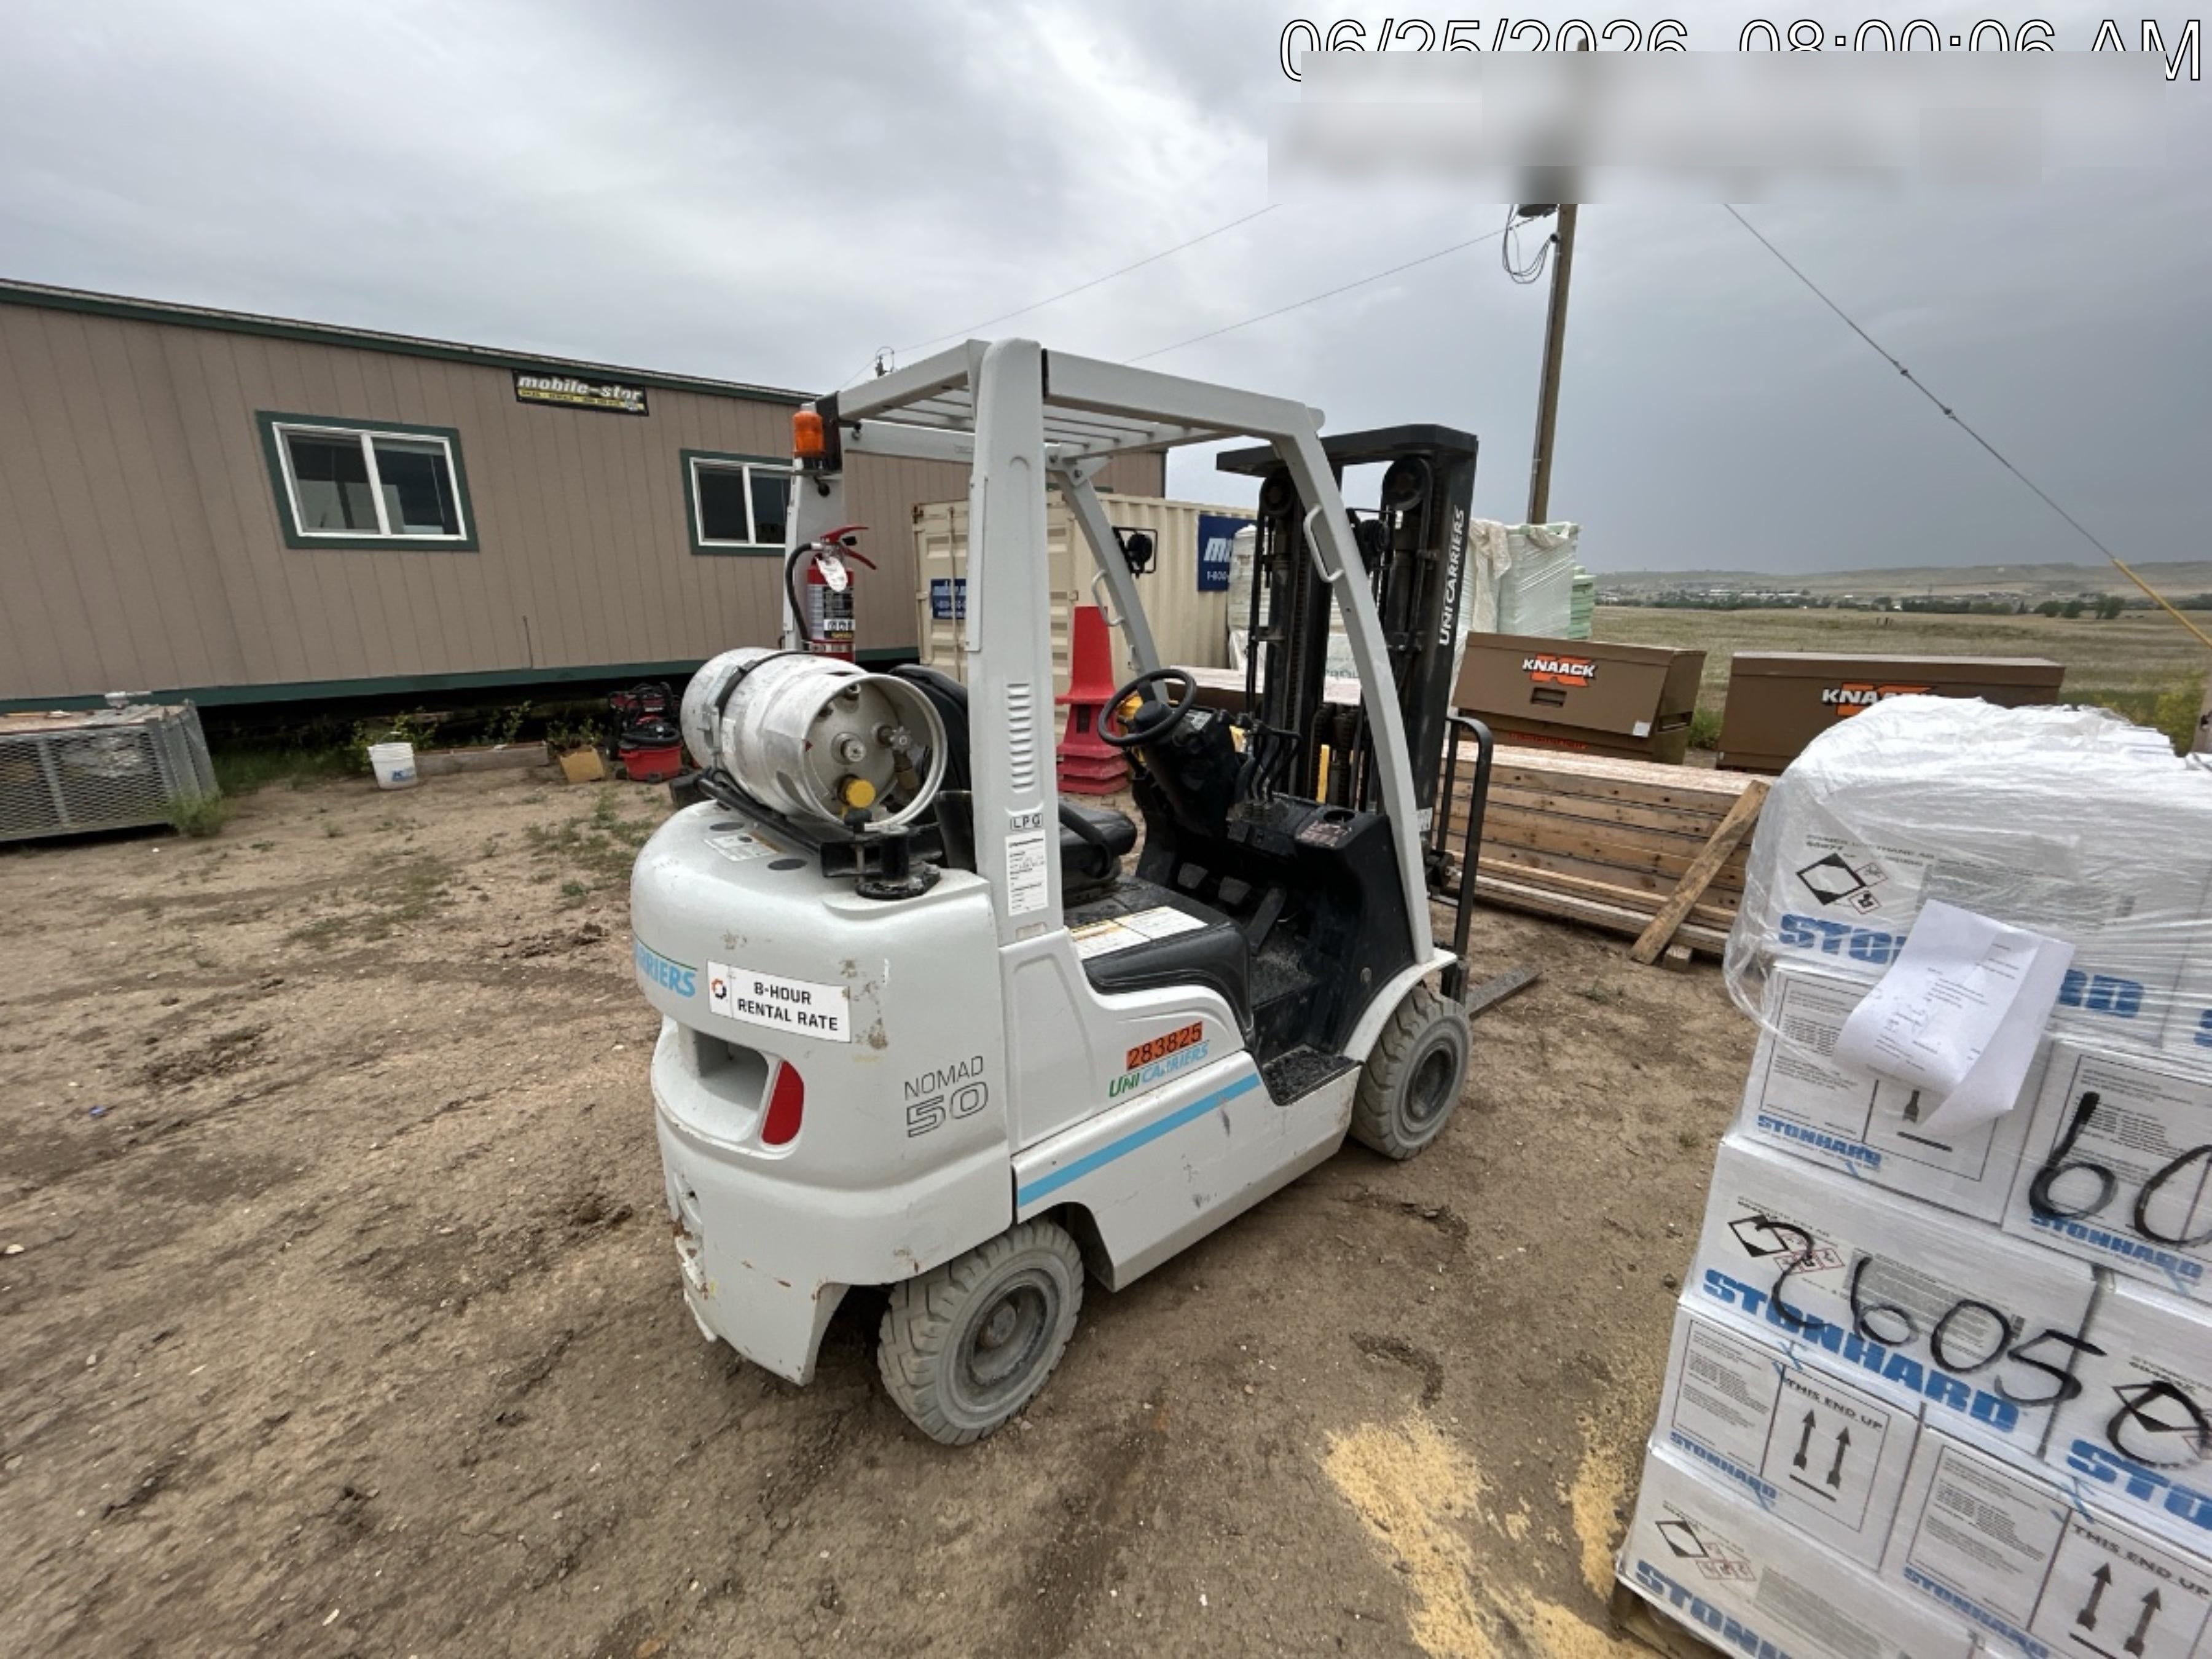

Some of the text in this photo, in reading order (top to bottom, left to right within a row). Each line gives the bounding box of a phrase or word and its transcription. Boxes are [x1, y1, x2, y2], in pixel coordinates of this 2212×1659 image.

[1522, 659, 1596, 677] KNAACK
[738, 998, 838, 1032] RENTAL RATE
[1127, 1021, 1202, 1071] 283825
[904, 1056, 983, 1101] NOMAD
[907, 1081, 989, 1138] 50
[1757, 1114, 1882, 1168] STONHARD
[1703, 1268, 2020, 1433] STONHARD
[1786, 1377, 1883, 1430] THIS END UP
[2073, 1523, 2211, 1598] THIS END UP
